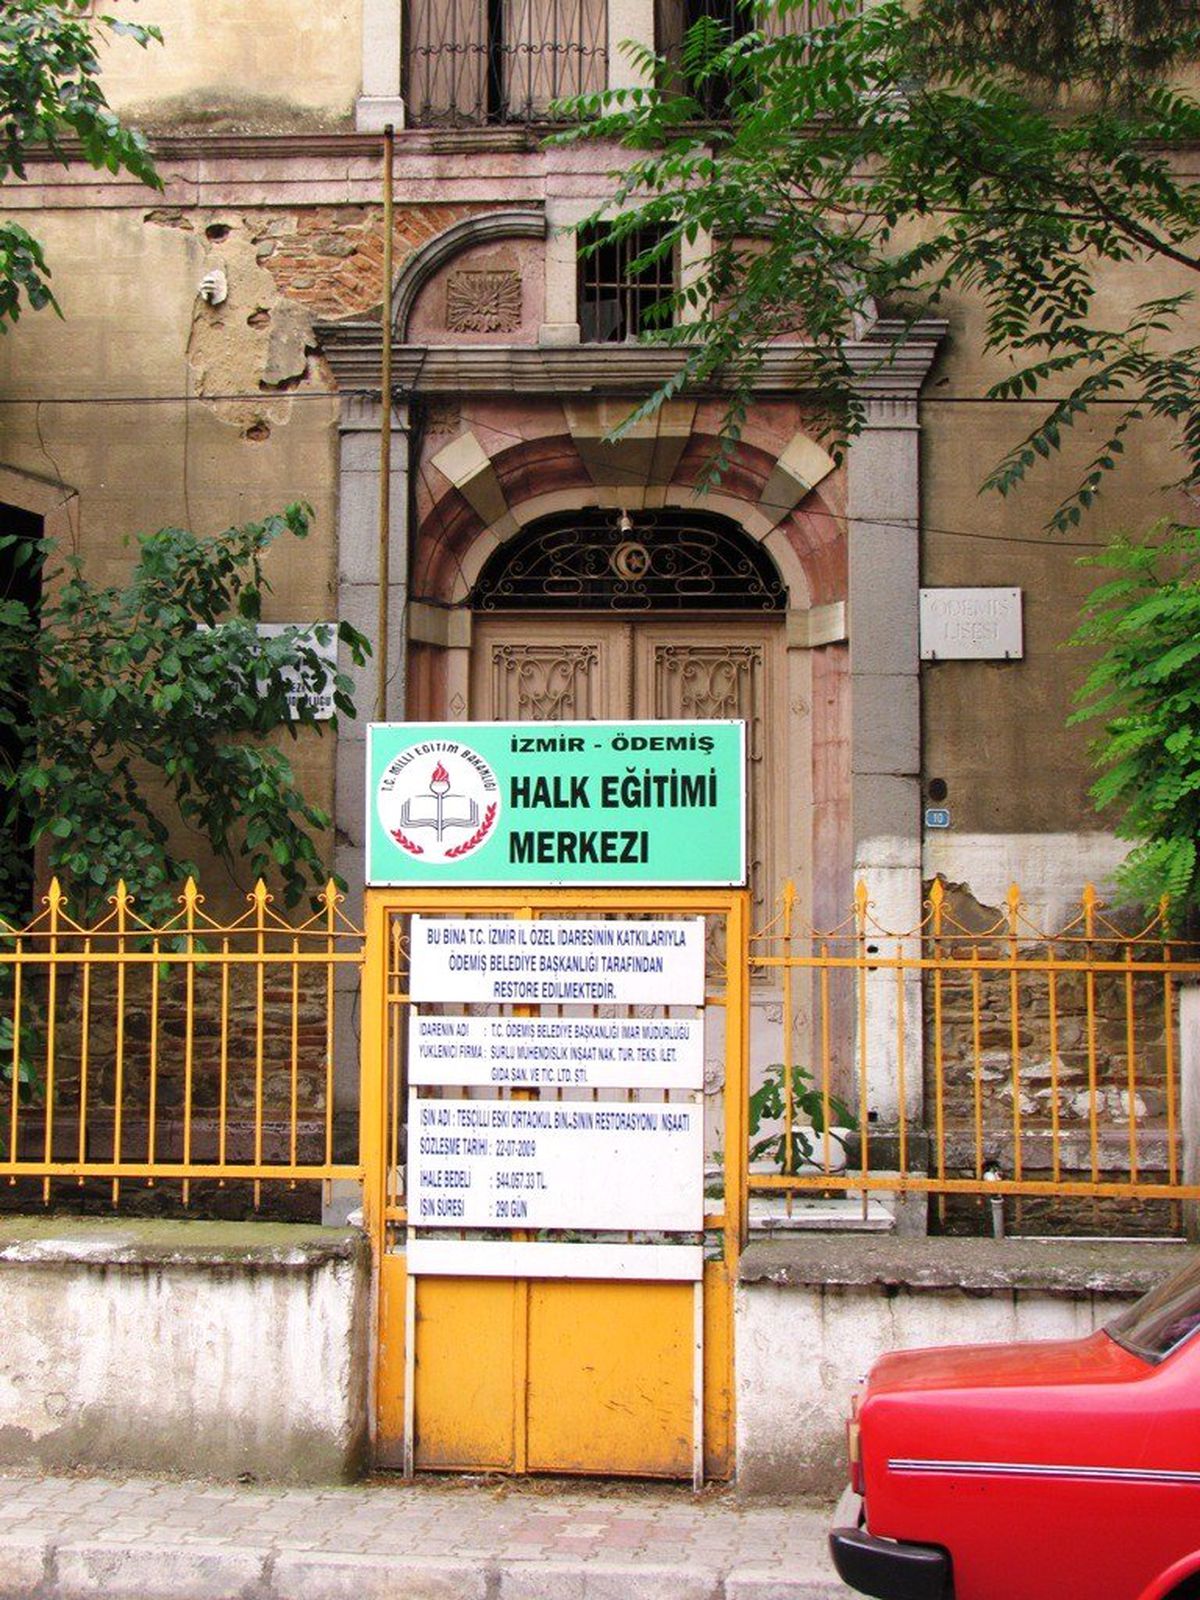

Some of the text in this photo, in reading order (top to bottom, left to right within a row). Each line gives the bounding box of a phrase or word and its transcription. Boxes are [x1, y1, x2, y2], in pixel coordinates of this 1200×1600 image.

[510, 734, 585, 753] İZMİR
[611, 732, 715, 755] ÖDEMİŞ
[510, 766, 718, 809] HALK EĞİTİMİ
[510, 831, 649, 864] MERKEZI
[427, 928, 441, 945] BU
[468, 928, 485, 945] T.C.
[601, 955, 663, 974] TARAFINDAN
[493, 981, 539, 998] RESTORE
